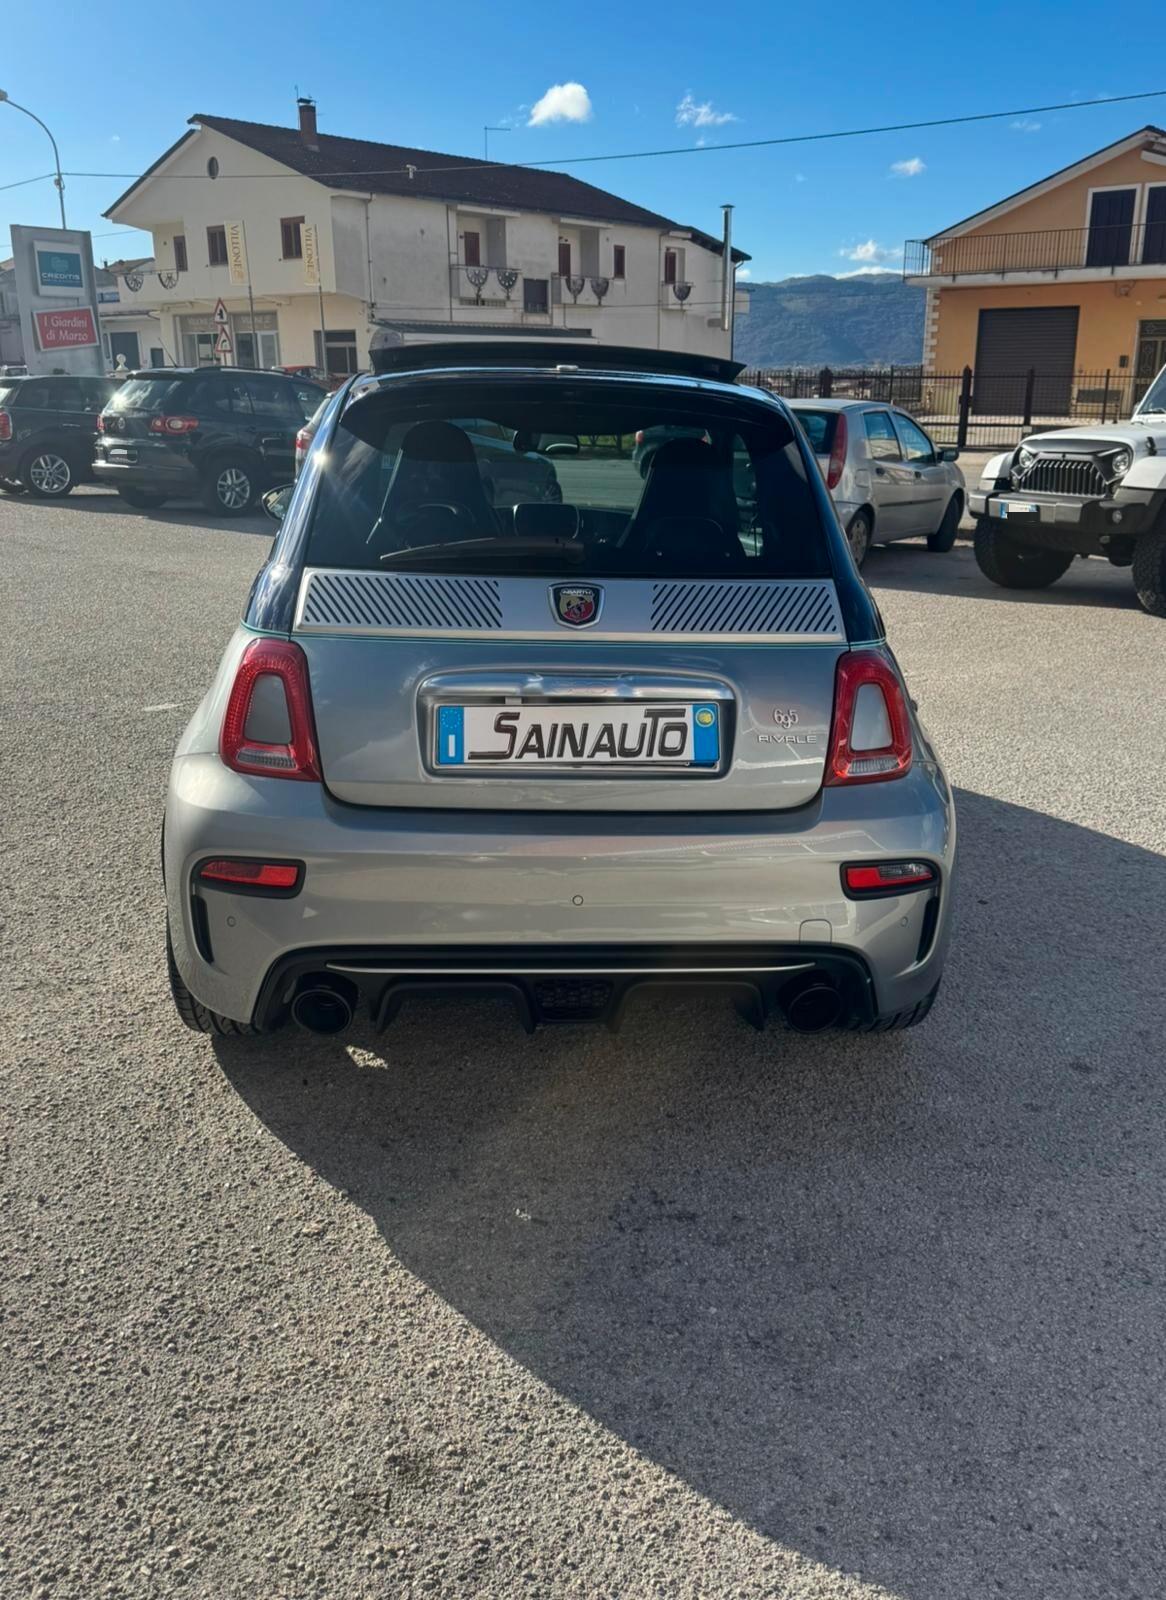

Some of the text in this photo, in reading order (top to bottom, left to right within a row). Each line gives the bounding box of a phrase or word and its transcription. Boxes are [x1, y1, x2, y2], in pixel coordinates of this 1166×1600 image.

[51, 315, 88, 327] Giardini
[46, 328, 89, 341] di Marzo
[758, 735, 817, 744] RIVALE
